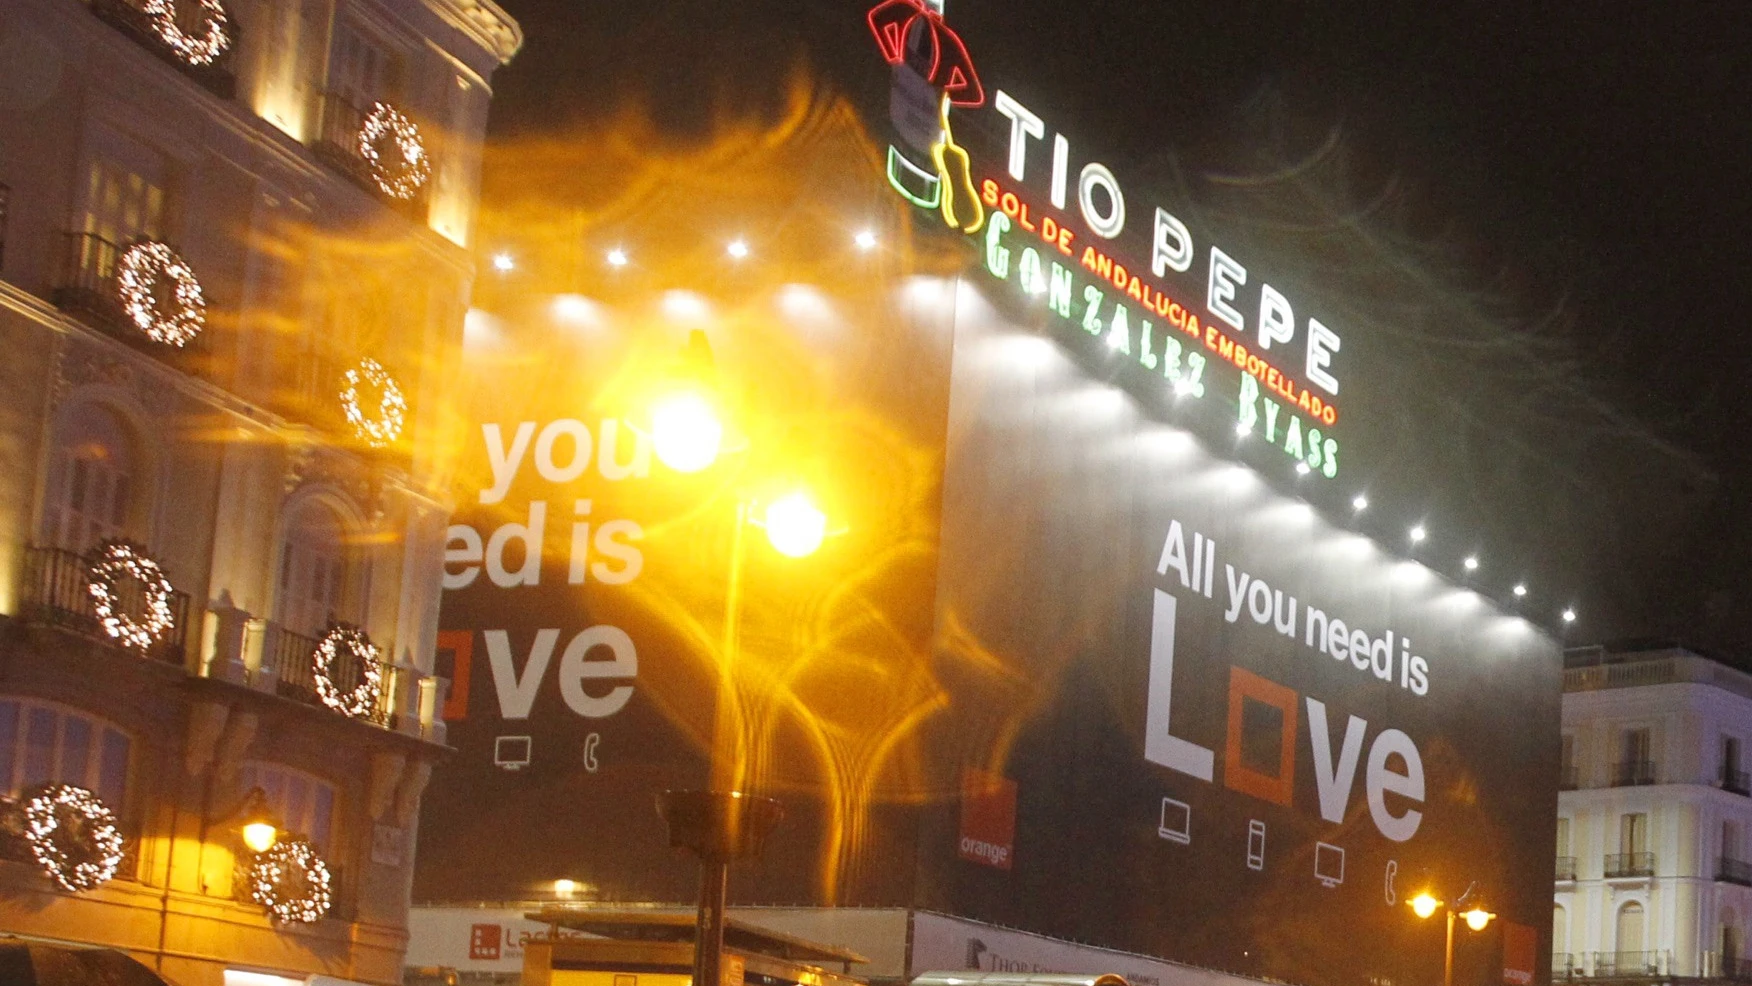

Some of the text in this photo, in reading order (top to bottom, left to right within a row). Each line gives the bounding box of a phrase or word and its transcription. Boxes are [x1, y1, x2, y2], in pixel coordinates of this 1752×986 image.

[981, 177, 1337, 426] SOL DE ANDALUCIA EMBOTELLADO
[995, 89, 1340, 395] TIO PEPE
[985, 210, 1338, 478] GONZALEZ BYASS
[442, 498, 645, 589] ed is
[479, 418, 651, 504] you
[1156, 519, 1429, 695] All you need is
[960, 836, 1008, 865] orange
